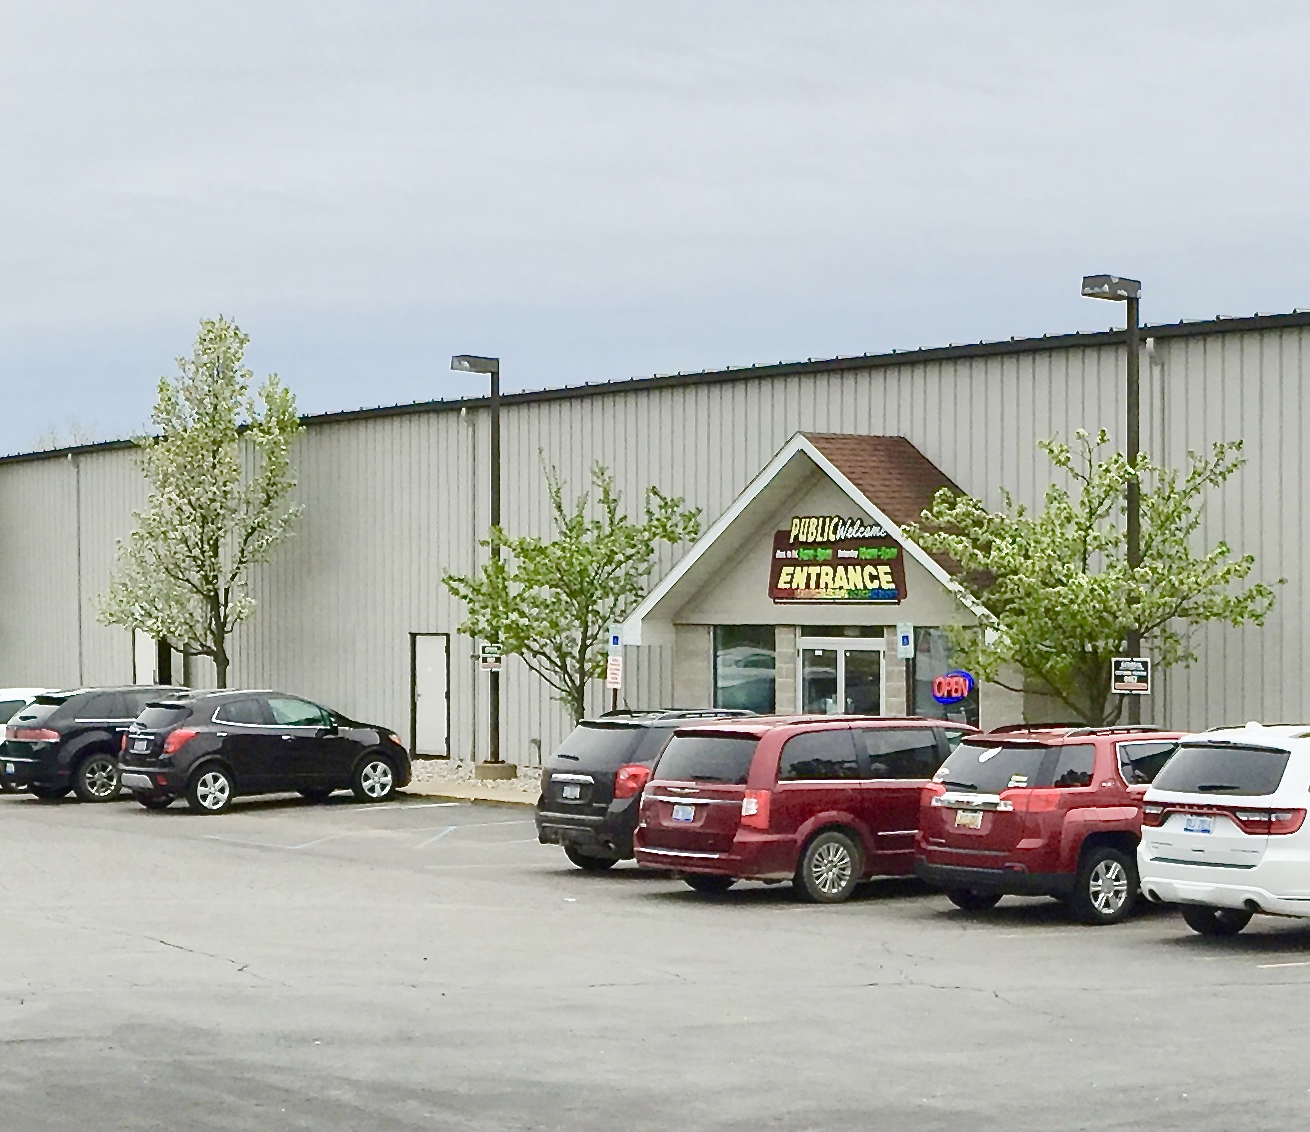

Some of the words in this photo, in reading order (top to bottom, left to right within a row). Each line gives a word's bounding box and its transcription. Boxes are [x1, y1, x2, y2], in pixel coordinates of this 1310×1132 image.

[789, 516, 839, 544] PUBLIC
[836, 519, 887, 541] Welcome
[777, 564, 897, 590] ENTRANCE
[932, 676, 970, 698] OPEN
